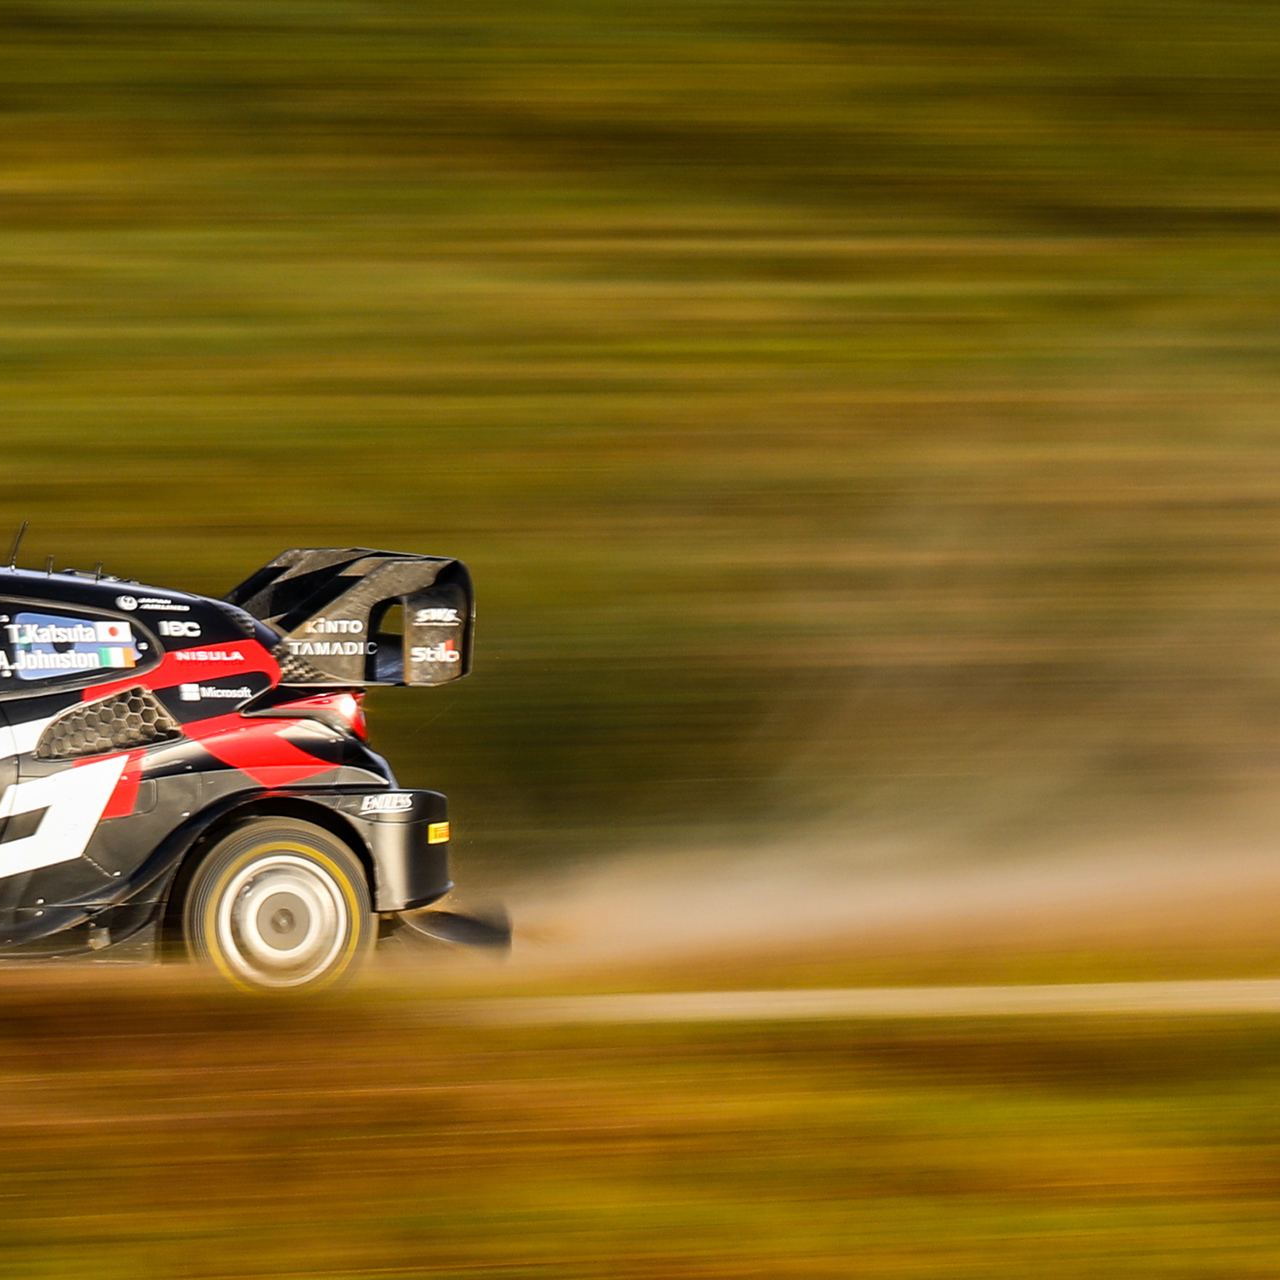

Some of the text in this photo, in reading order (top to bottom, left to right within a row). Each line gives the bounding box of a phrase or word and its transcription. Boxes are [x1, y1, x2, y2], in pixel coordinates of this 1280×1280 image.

[176, 651, 245, 661] NISULA
[288, 642, 378, 656] TAMADIC
[410, 640, 460, 662] Stilo
[200, 686, 253, 698] Microsoft
[360, 793, 414, 811] ENDLESS
